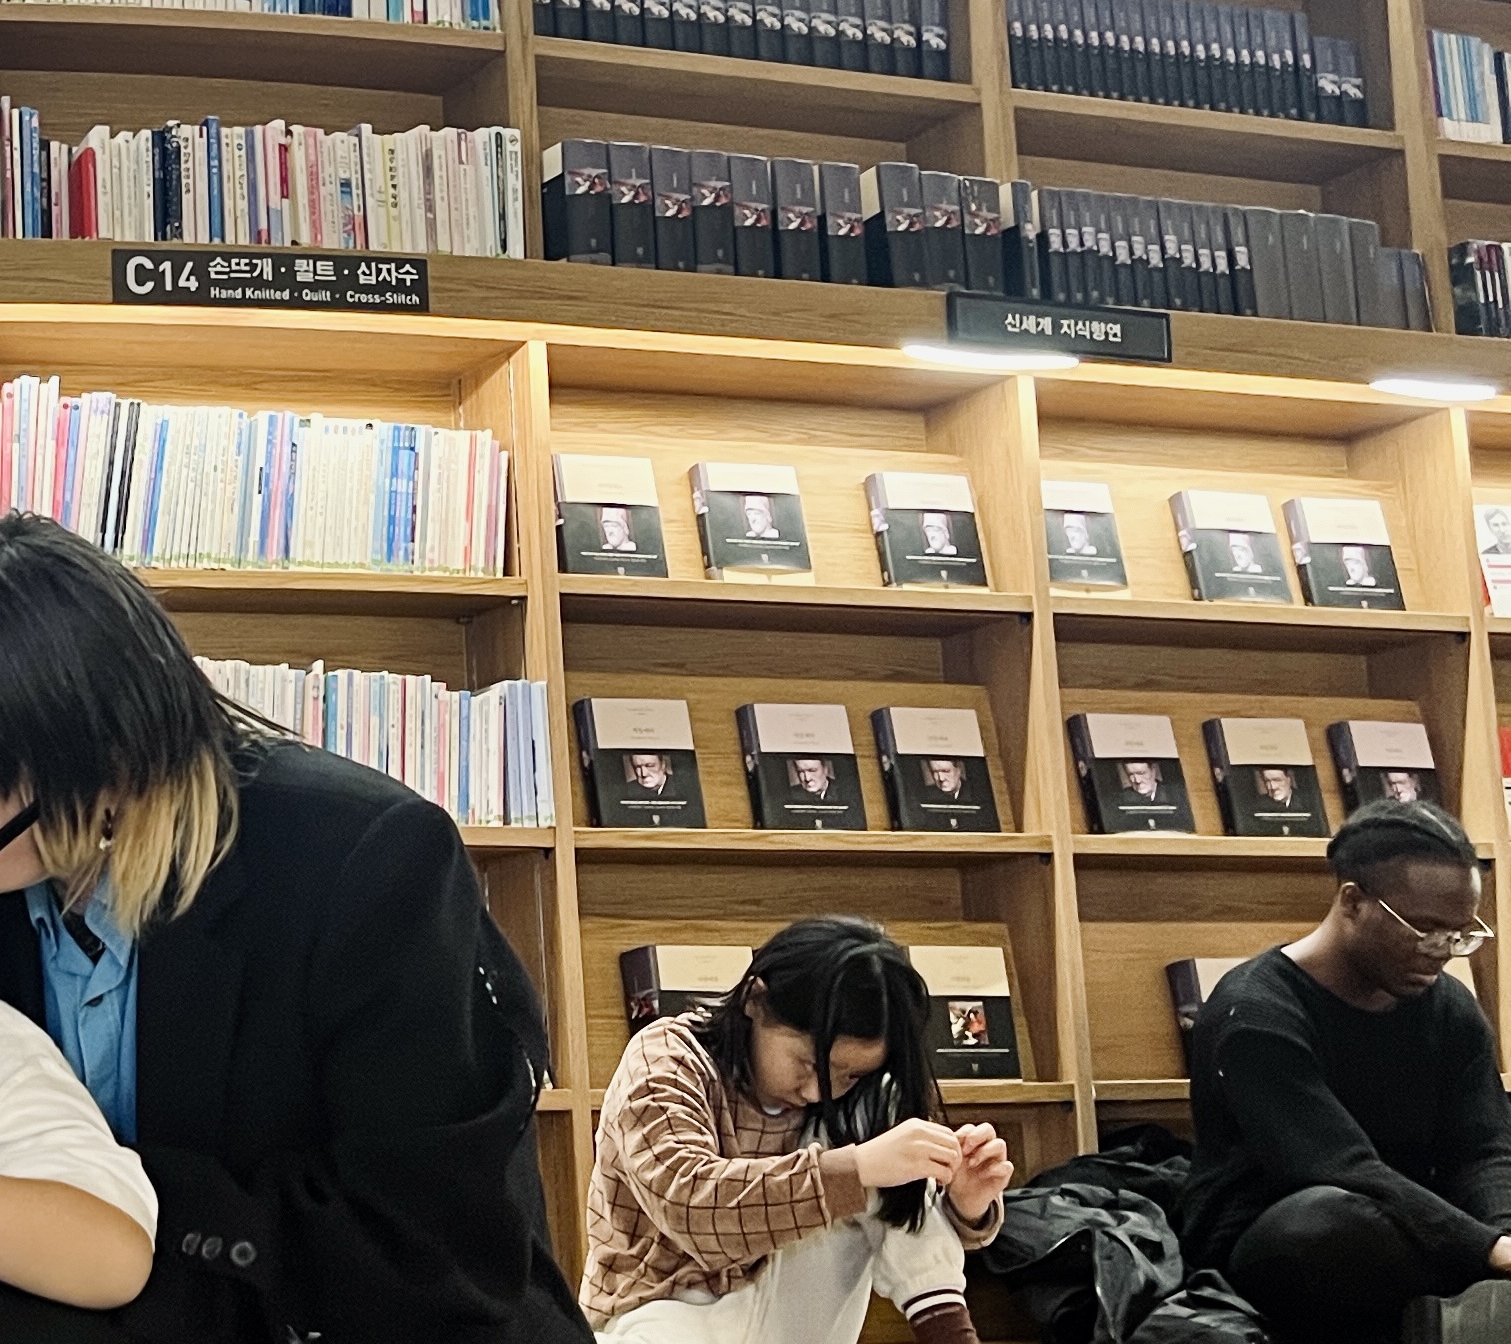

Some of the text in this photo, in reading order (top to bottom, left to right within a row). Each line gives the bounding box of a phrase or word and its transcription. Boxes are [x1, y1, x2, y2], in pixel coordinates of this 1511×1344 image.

[126, 256, 199, 295] C14
[208, 256, 419, 287] 손뜨개 퀼트 십자수
[210, 287, 420, 305] Hand Knitted Quilt Cross-Stitch
[1004, 313, 1122, 343] 신세계 지식향연
